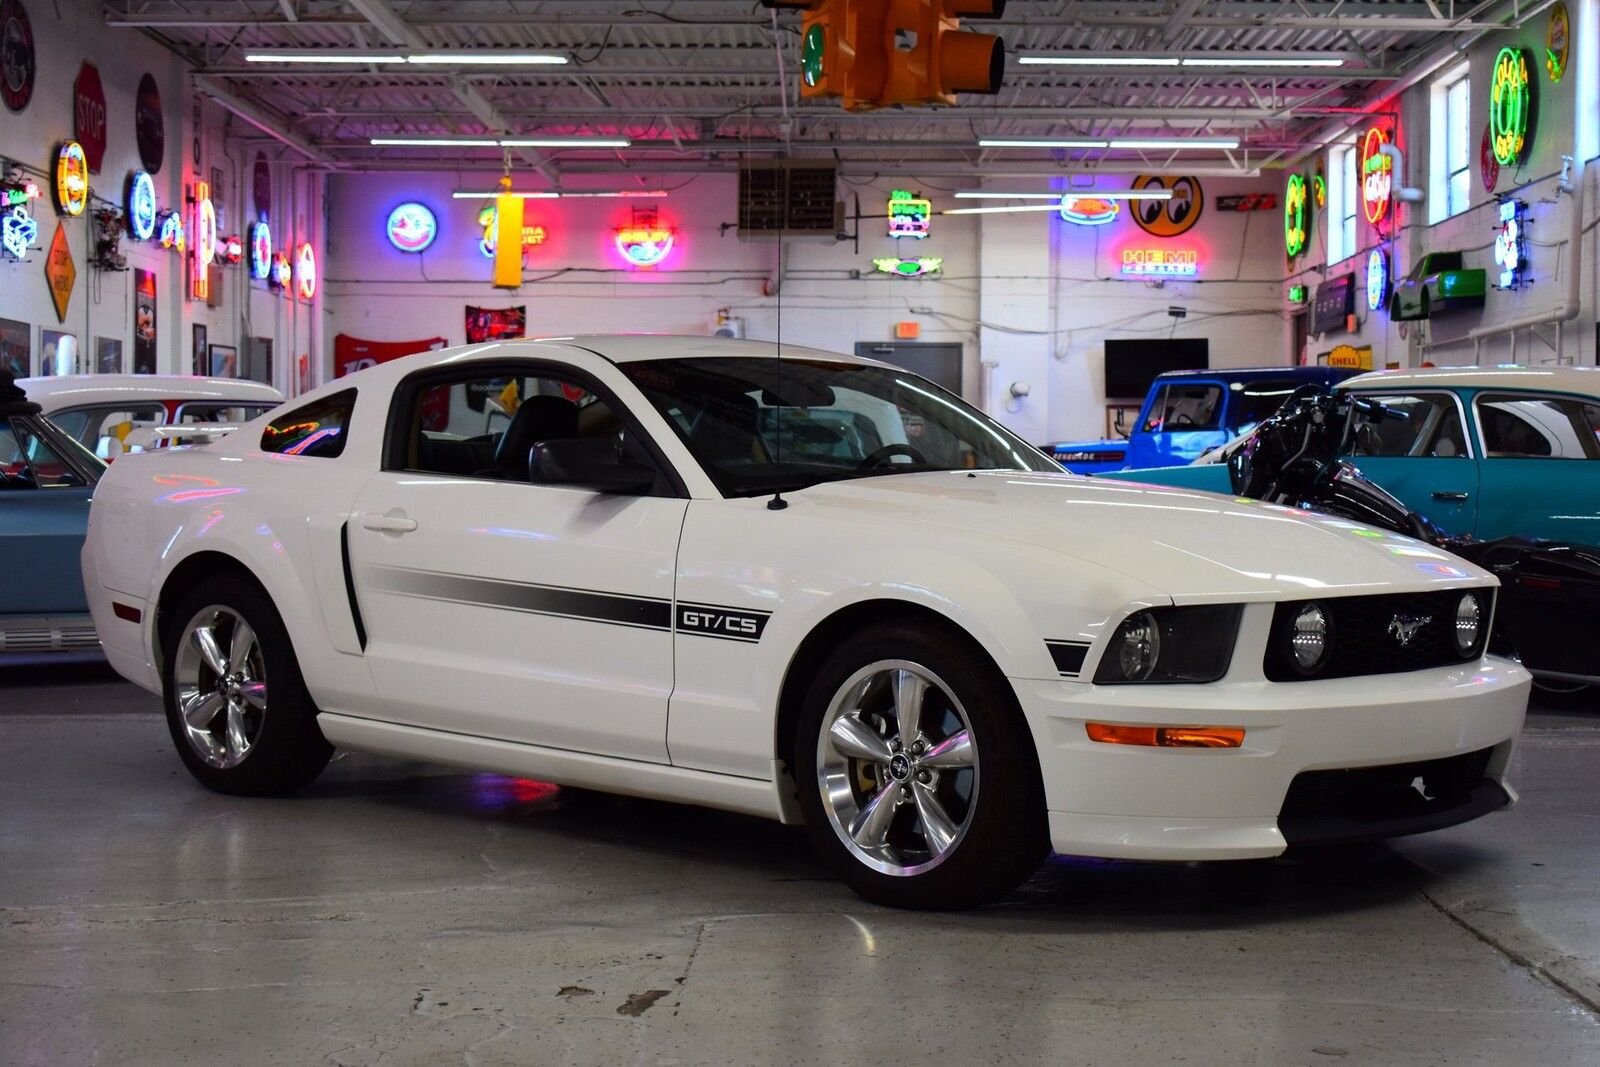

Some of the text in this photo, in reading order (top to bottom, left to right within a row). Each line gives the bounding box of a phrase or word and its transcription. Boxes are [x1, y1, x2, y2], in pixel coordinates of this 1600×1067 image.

[79, 93, 104, 139] STOP
[1123, 250, 1197, 264] HEMI
[1331, 357, 1357, 366] SHELL
[683, 611, 757, 633] GT/CS
